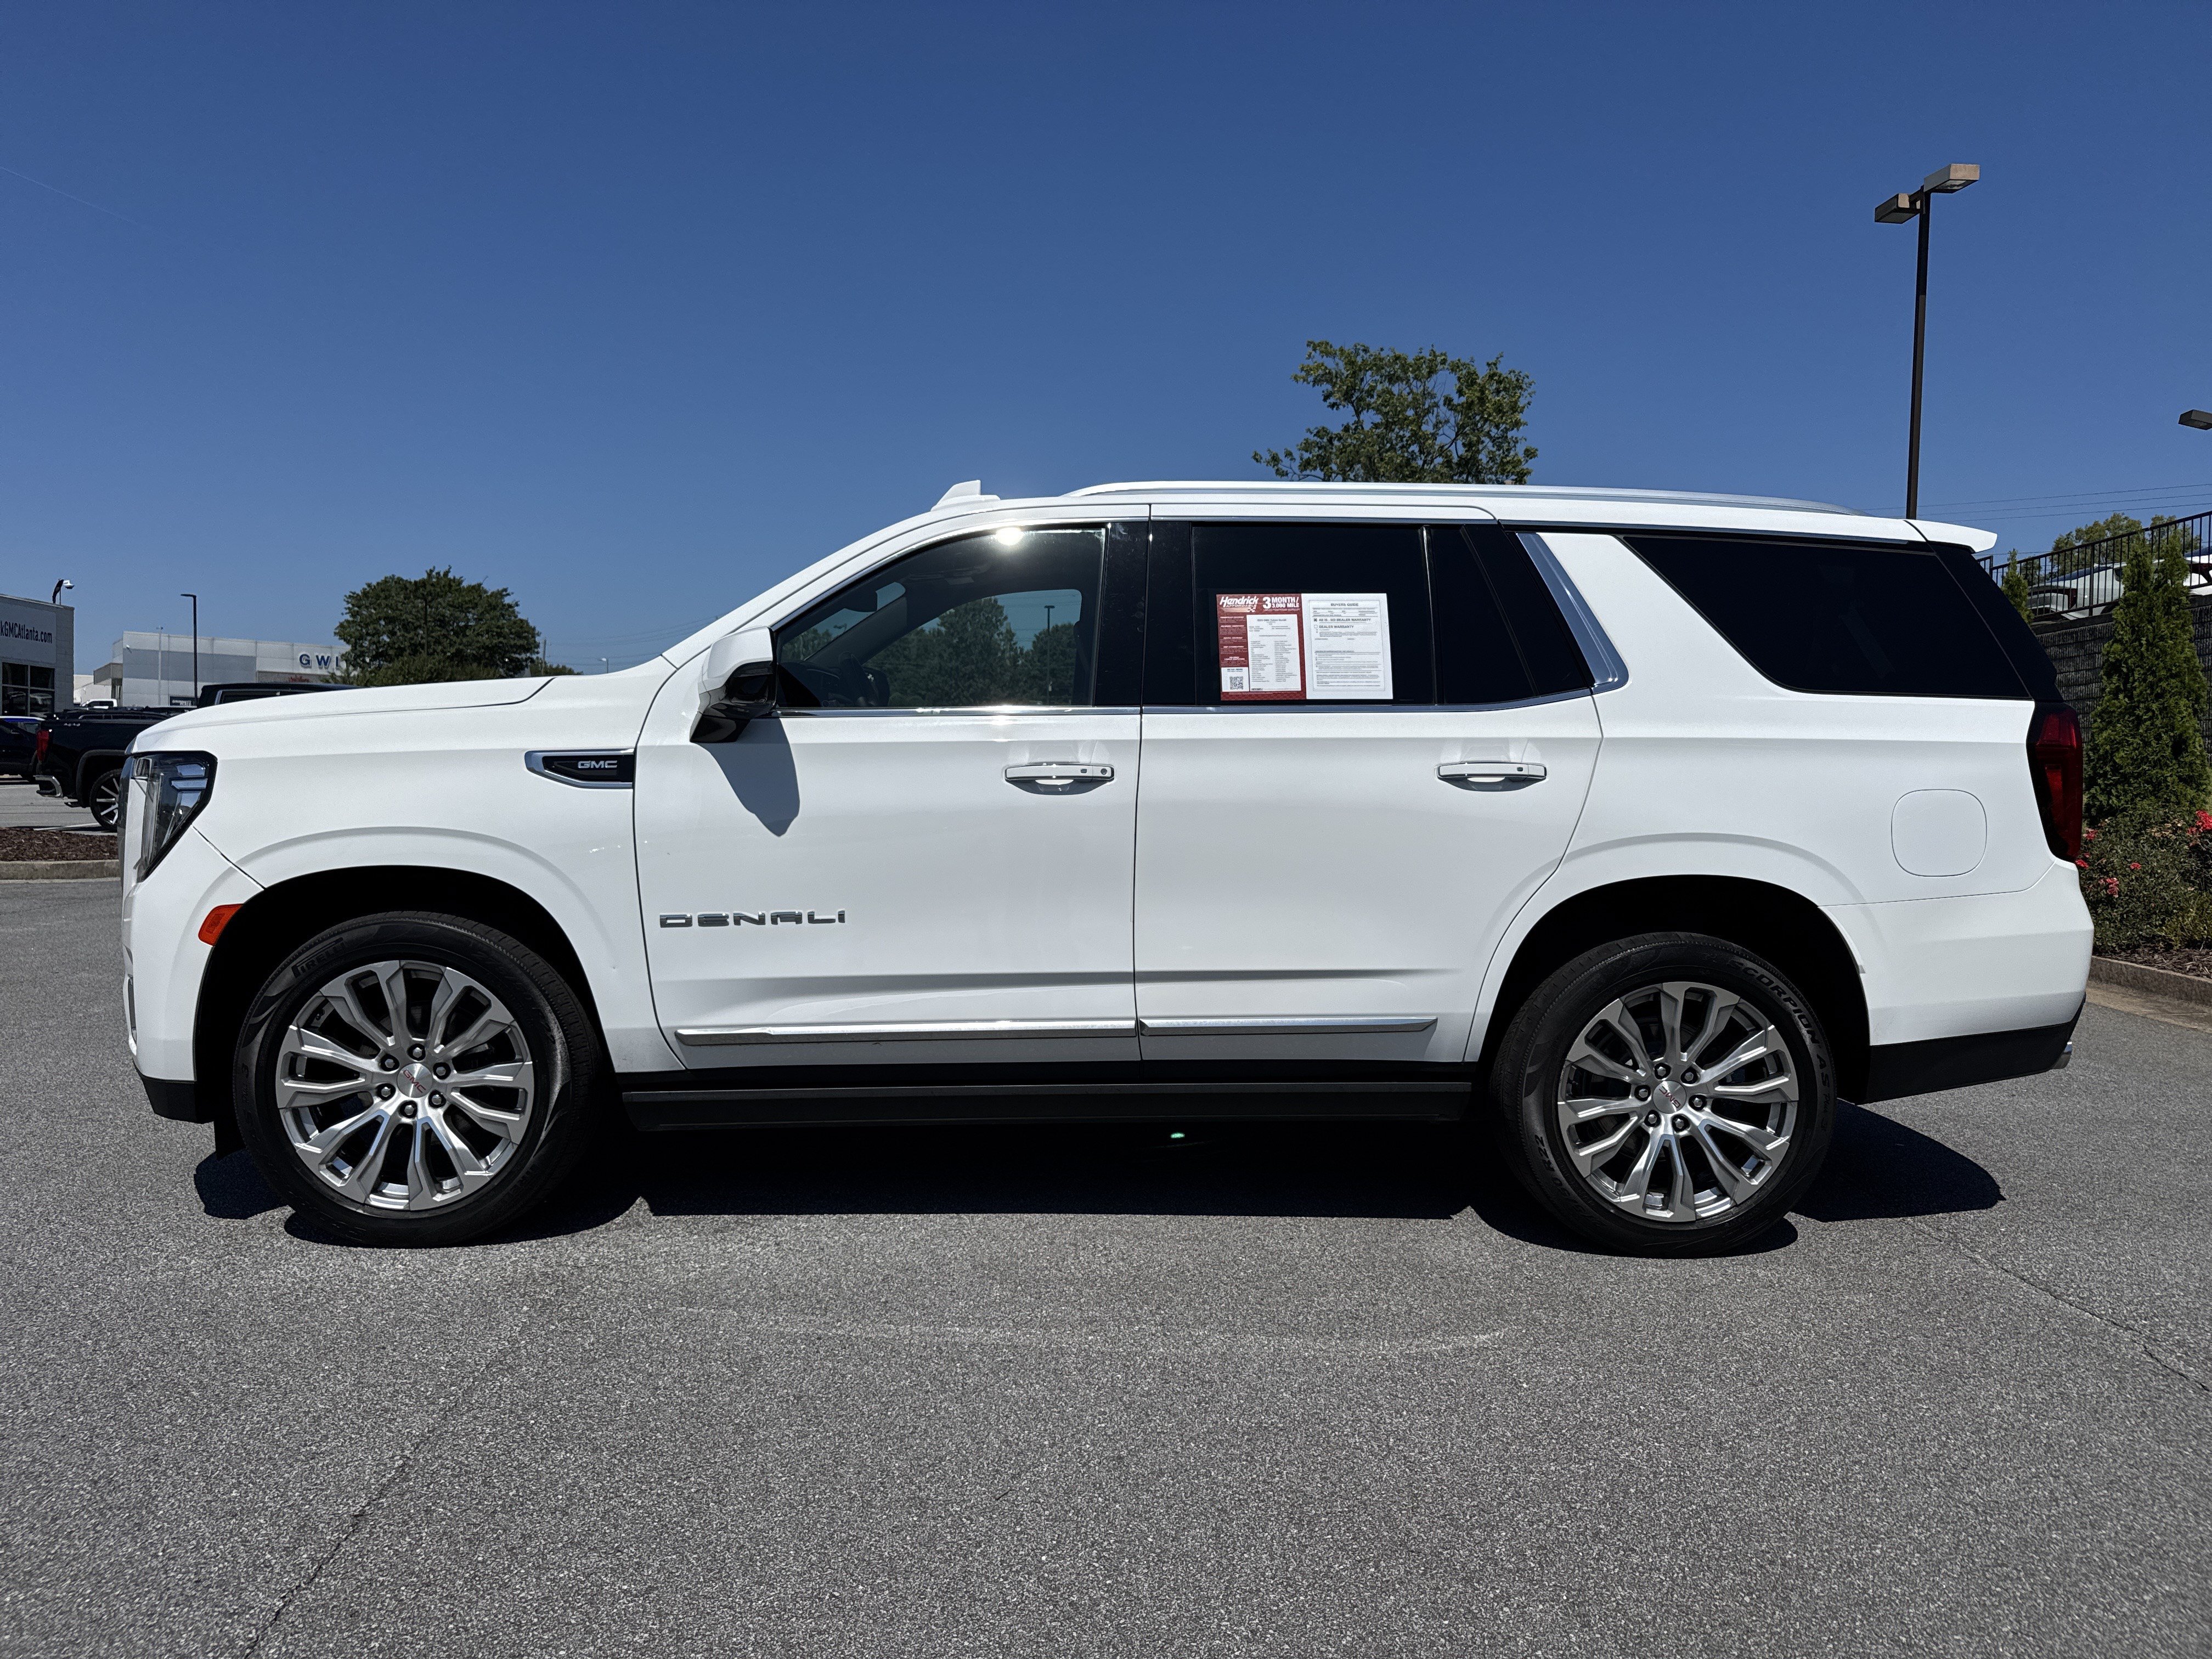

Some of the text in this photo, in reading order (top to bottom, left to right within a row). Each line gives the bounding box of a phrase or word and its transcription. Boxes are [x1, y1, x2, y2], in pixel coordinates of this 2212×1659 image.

[1220, 596, 1259, 607] Hendrick
[1263, 596, 1272, 609] 3
[578, 760, 618, 769] GMC
[659, 909, 846, 928] DENALI
[291, 937, 345, 978] PIRELLI
[1726, 957, 1820, 1044] SCORPION
[1816, 1053, 1830, 1087] AS
[403, 1069, 426, 1093] GMC
[1658, 1086, 1681, 1109] GMC
[1534, 1135, 1555, 1172] R22
